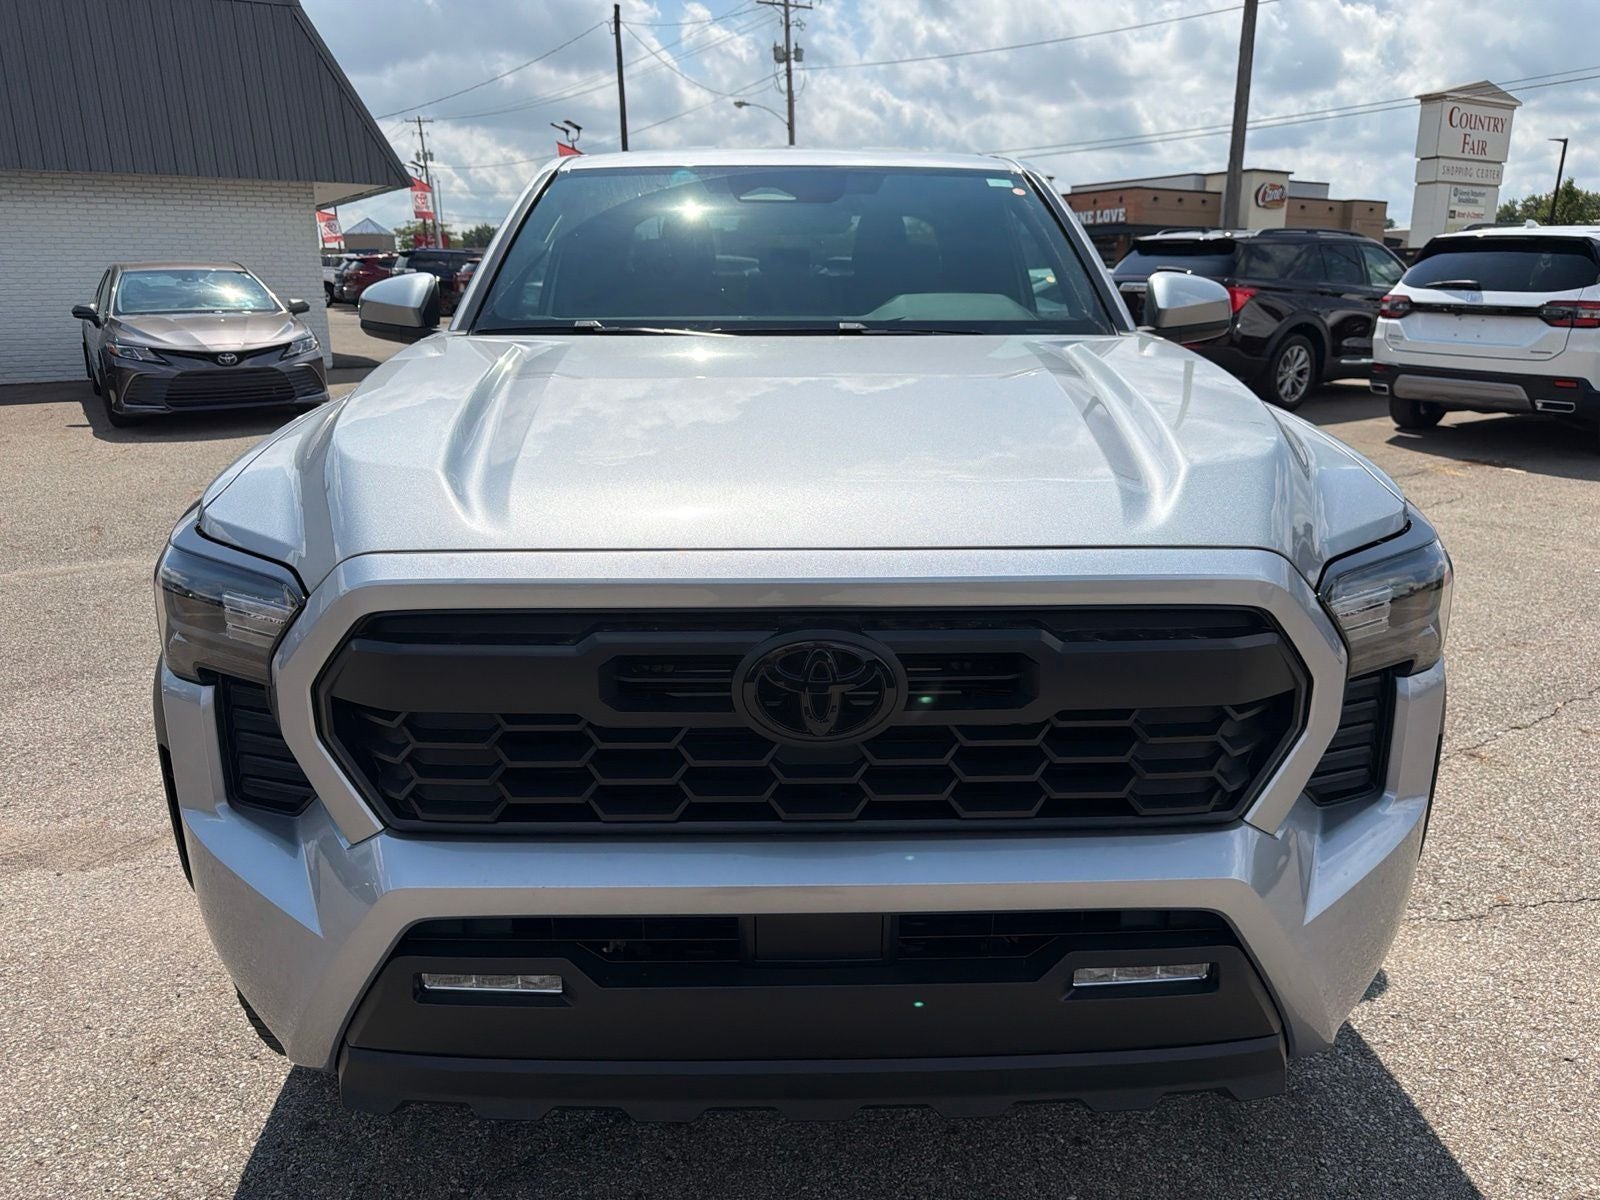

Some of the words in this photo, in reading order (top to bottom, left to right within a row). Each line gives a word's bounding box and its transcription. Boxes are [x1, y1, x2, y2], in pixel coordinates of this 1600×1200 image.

[1448, 106, 1507, 134] COUNTRY
[1461, 133, 1488, 156] FAIR
[1442, 165, 1473, 177] SHOPPING
[1476, 167, 1500, 179] CENTER
[1096, 208, 1126, 223] LOVE
